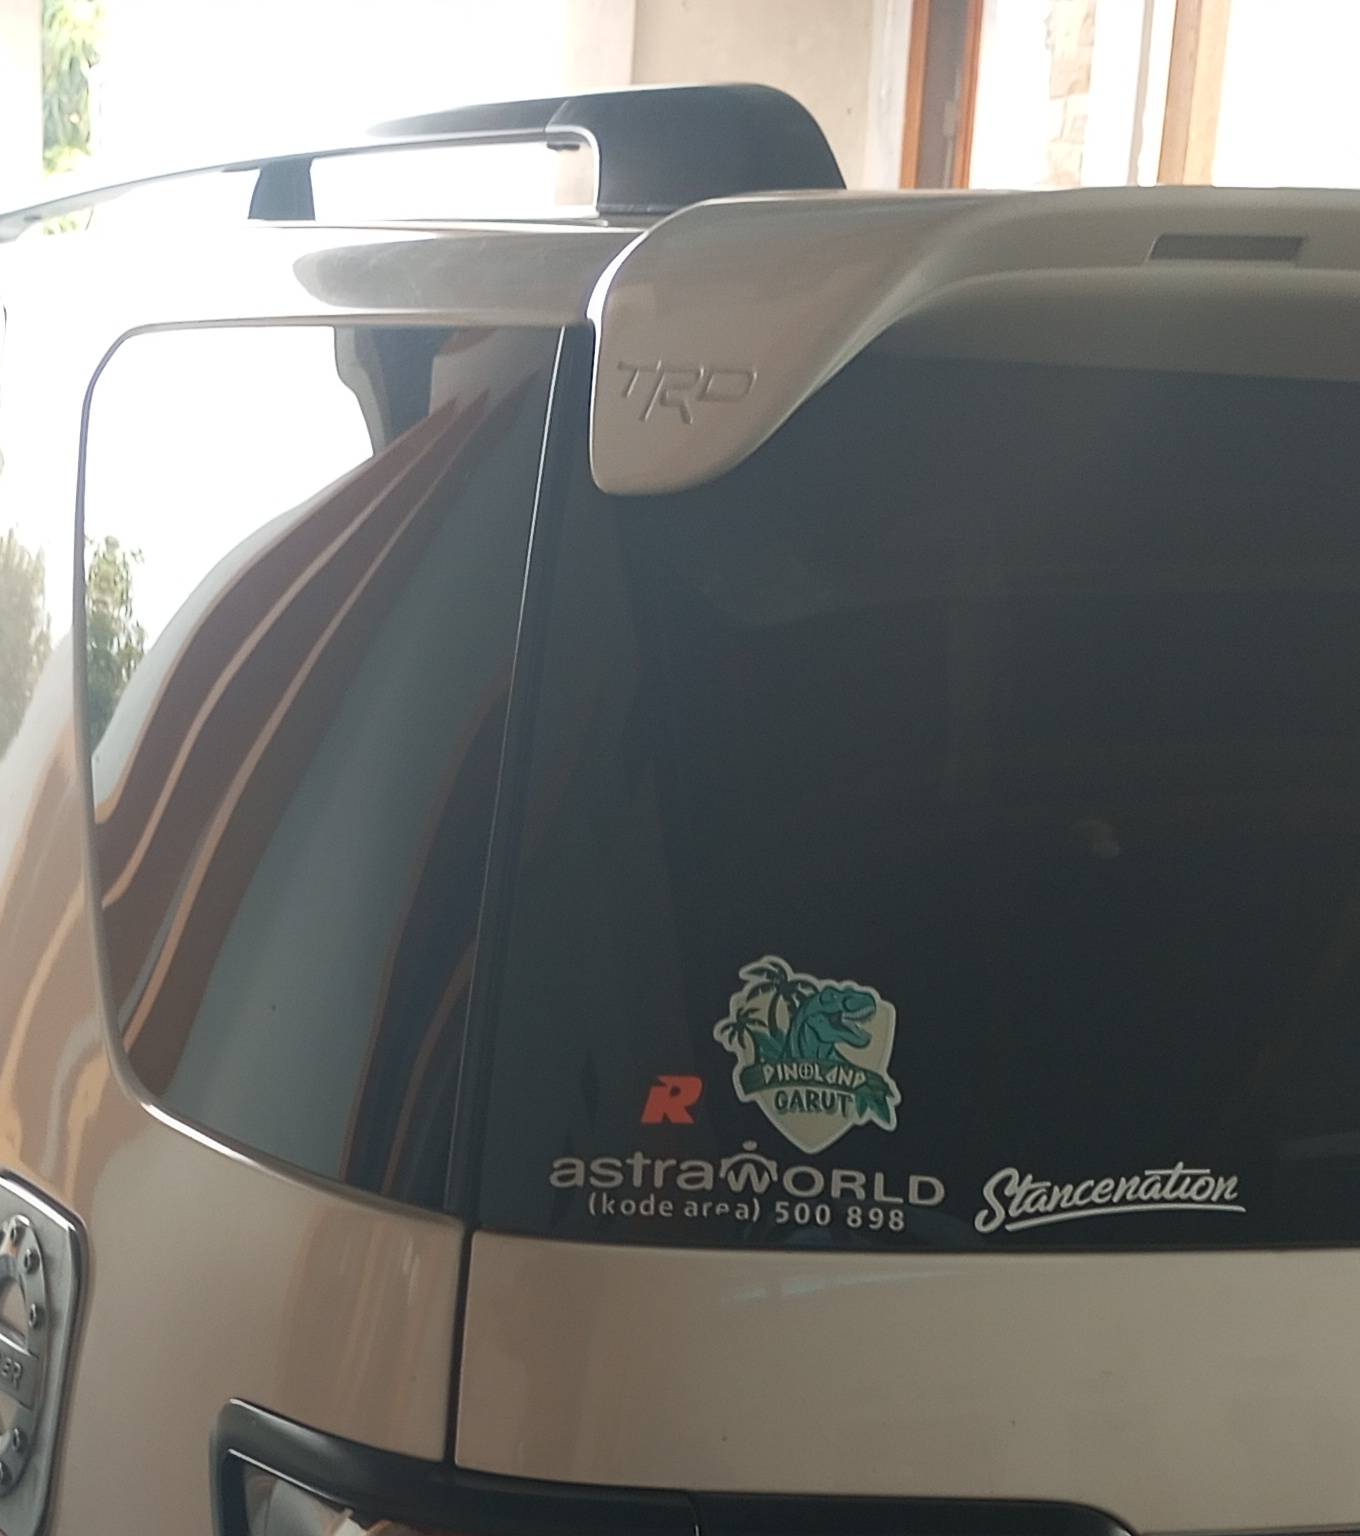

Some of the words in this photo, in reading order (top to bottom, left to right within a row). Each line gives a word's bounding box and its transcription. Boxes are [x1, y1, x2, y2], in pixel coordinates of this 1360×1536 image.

[617, 361, 758, 425] TRD
[763, 1061, 867, 1089] DINOLAND
[641, 1074, 704, 1125] R
[774, 1088, 855, 1118] GARUT
[588, 1191, 674, 1219] (kode
[684, 1197, 761, 1223] area)
[775, 1200, 832, 1227] 500
[846, 1205, 906, 1232] 898
[973, 1161, 1246, 1234] Stancenation
